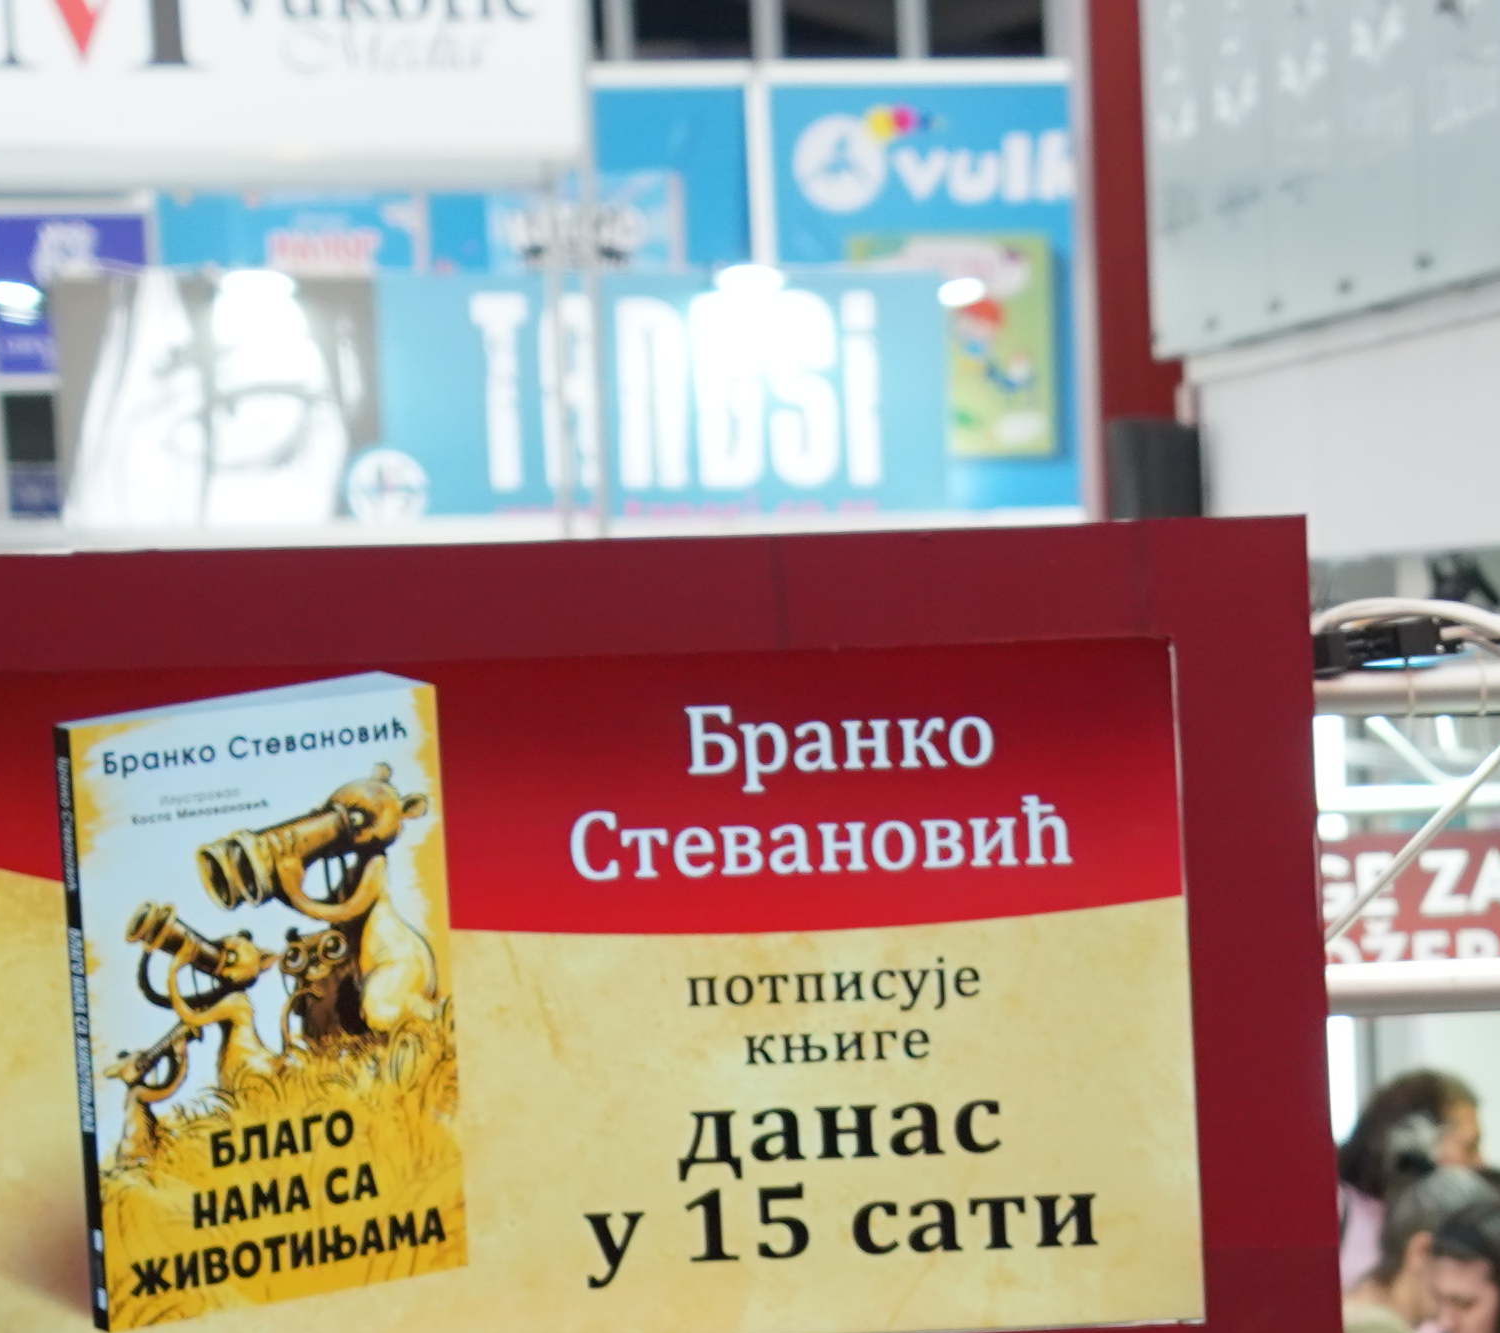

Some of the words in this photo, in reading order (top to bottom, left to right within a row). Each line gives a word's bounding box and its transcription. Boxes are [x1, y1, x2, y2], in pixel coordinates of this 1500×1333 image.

[102, 748, 217, 778] Бранко
[228, 717, 408, 760] Стевановић
[684, 704, 994, 793] Бранко
[570, 795, 1073, 881] Стевановић
[686, 957, 981, 1010] потписује
[745, 1028, 931, 1066] књиге
[209, 1109, 354, 1168] БЛАГО
[678, 1099, 1002, 1182] данас
[192, 1173, 311, 1229] НАМА
[324, 1162, 379, 1205] СА
[130, 1206, 446, 1298] ЖИВОТИЊАМА
[583, 1211, 645, 1289] у
[685, 1182, 810, 1262] 15
[851, 1192, 1099, 1256] сати
